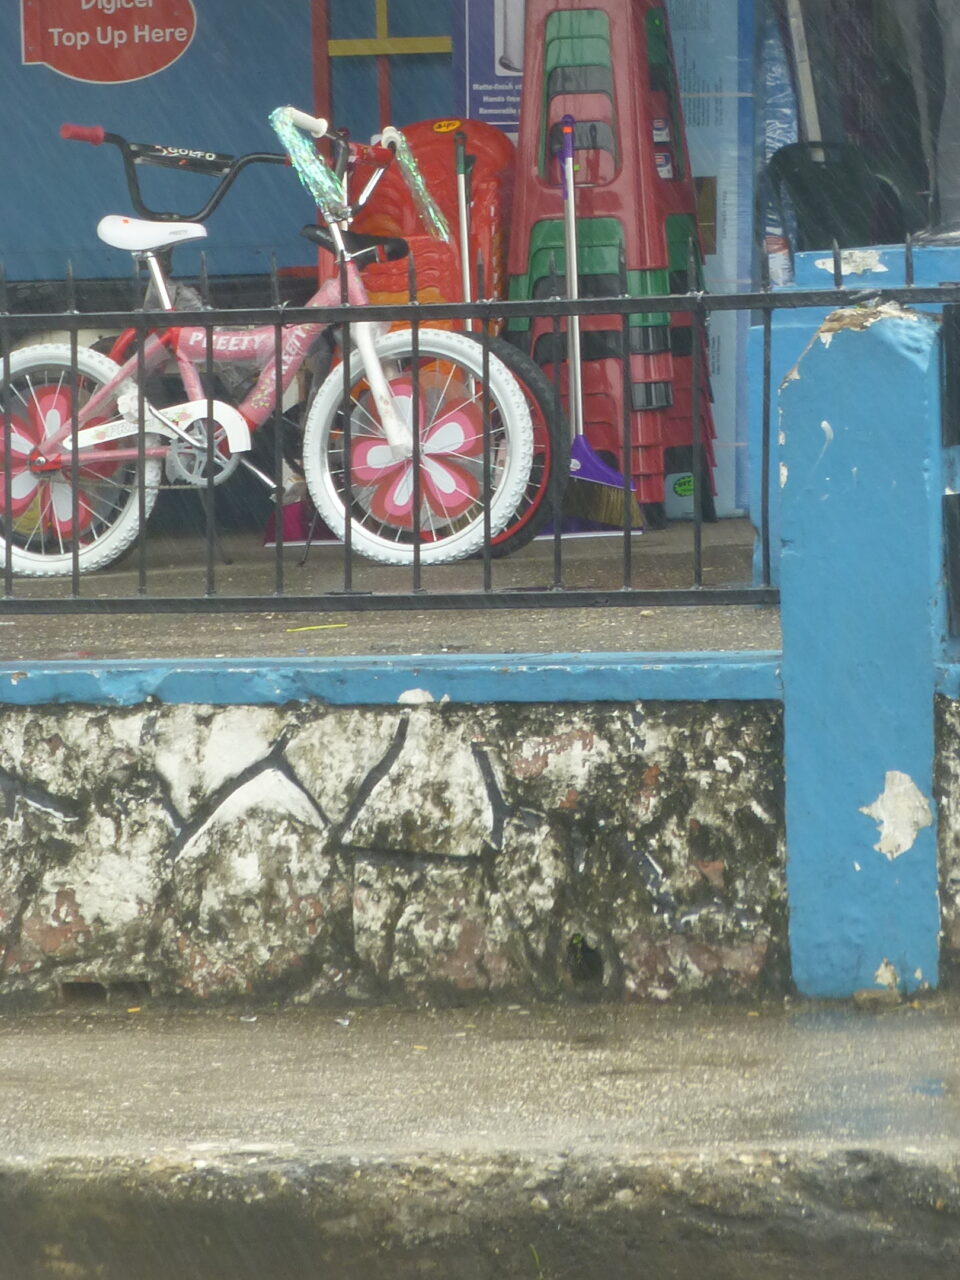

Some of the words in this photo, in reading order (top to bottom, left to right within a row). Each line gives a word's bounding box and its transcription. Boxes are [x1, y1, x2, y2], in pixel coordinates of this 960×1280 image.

[48, 28, 90, 50] Top
[97, 26, 127, 49] Up
[134, 24, 188, 43] Here
